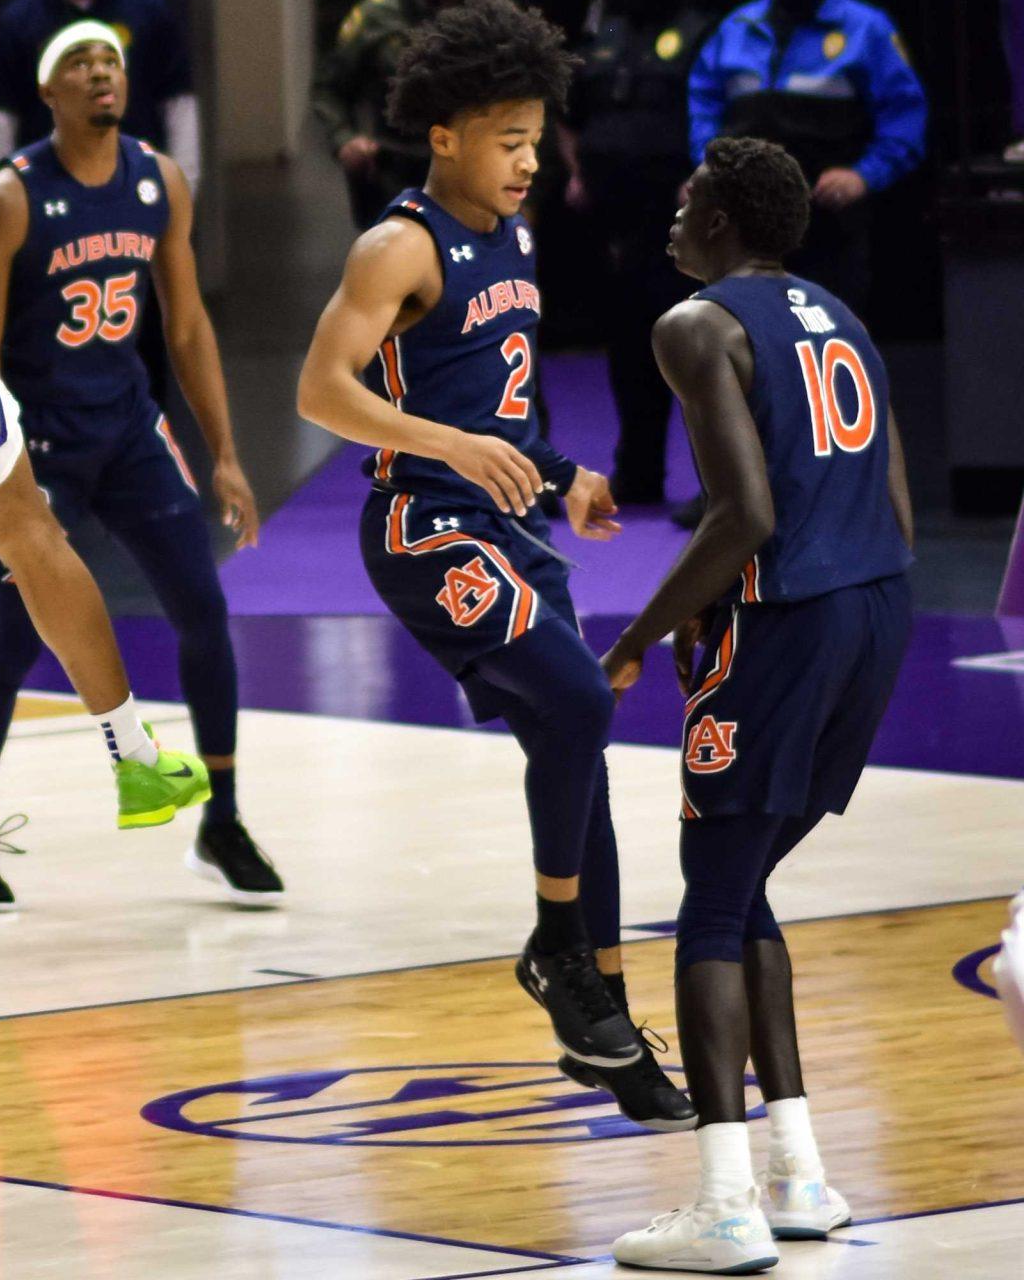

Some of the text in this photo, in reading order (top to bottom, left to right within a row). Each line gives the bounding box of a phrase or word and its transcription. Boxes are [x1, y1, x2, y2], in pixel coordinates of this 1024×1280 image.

[47, 231, 156, 276] AUBURN
[56, 270, 137, 348] 35
[461, 279, 541, 335] AUBUR
[495, 332, 531, 420] 2
[794, 338, 875, 457] 10
